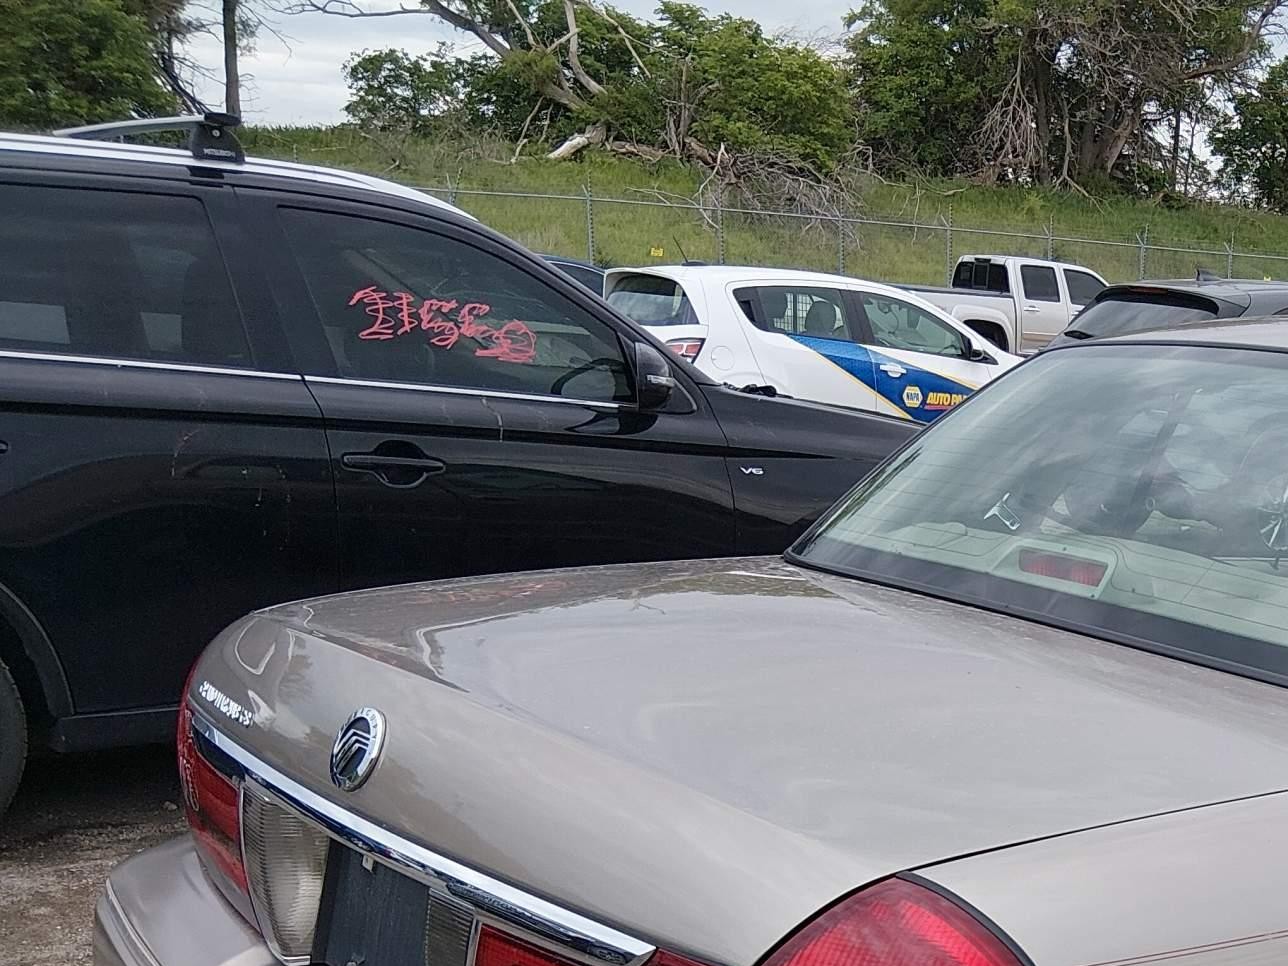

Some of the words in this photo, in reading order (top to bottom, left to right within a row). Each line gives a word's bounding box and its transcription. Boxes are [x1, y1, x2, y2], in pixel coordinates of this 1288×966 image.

[905, 392, 920, 403] NAPA
[926, 392, 951, 406] AUTO
[740, 466, 764, 475] V6
